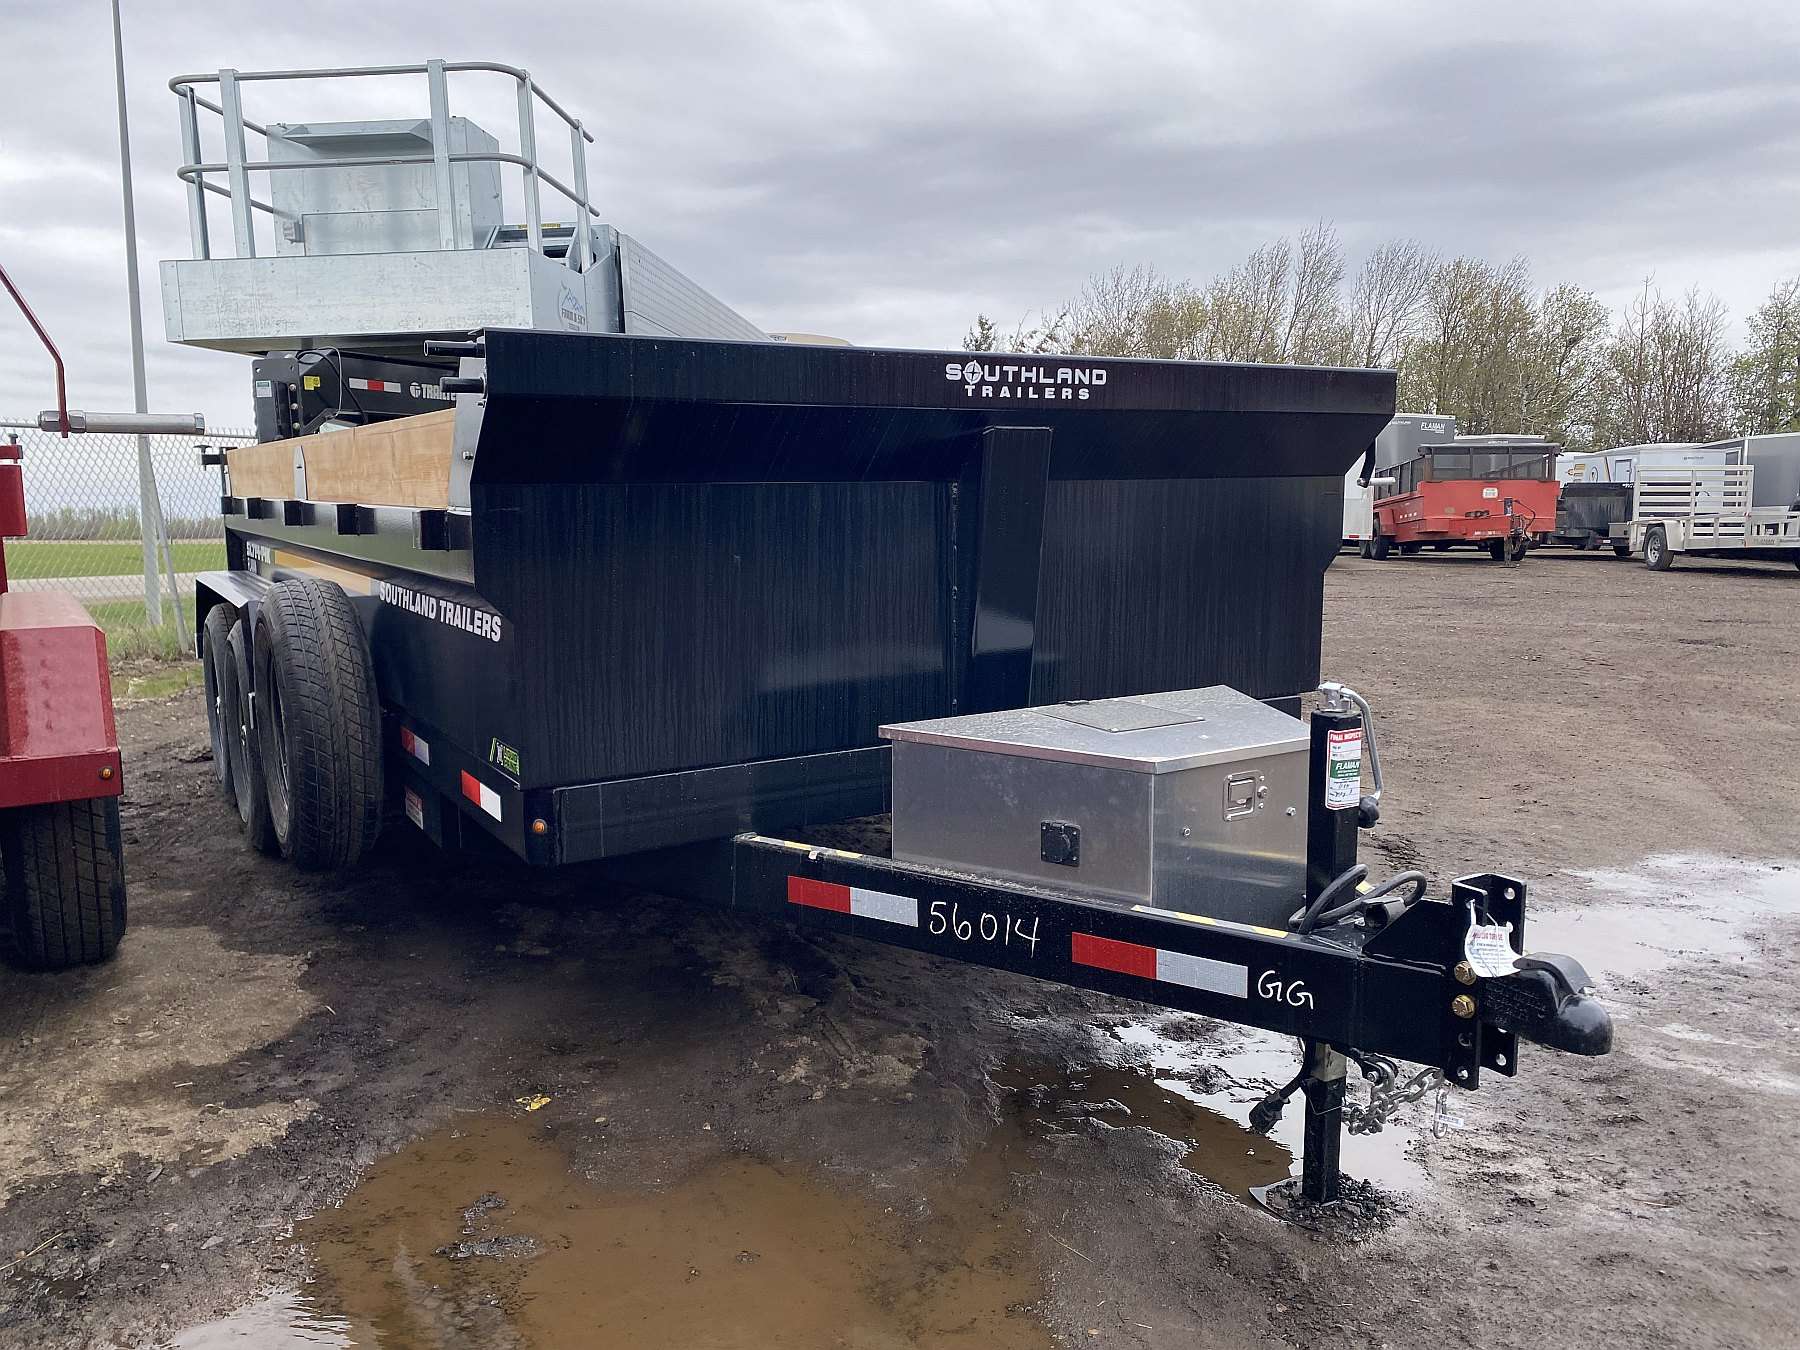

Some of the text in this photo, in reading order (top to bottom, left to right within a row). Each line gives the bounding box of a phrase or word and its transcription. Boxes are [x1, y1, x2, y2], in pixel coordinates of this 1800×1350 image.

[945, 360, 1107, 385] SOUTHLAND
[965, 384, 1090, 400] TRAILERS
[380, 580, 502, 643] SOUTHLAND TRAILERS
[928, 900, 1041, 958] 56014
